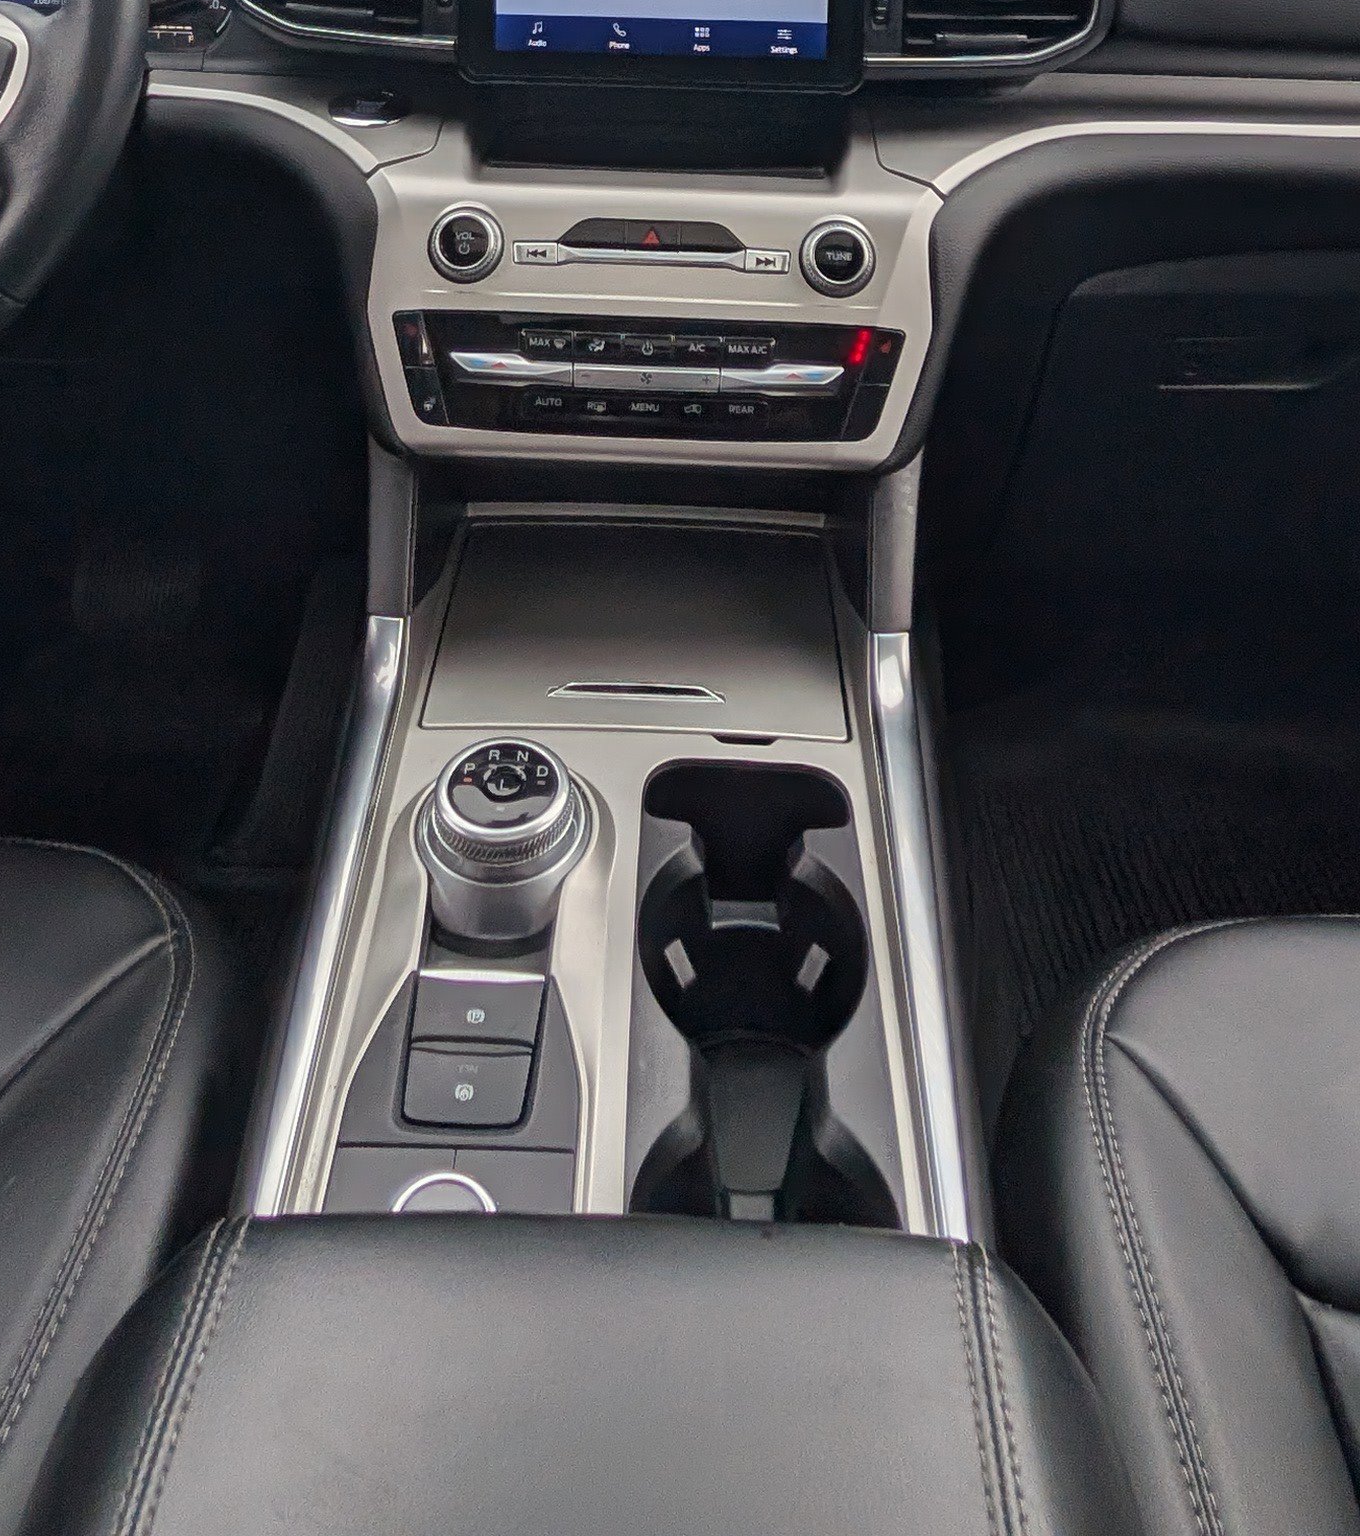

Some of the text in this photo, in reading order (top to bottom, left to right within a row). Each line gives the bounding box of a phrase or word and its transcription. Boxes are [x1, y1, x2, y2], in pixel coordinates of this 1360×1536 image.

[527, 39, 548, 47] Audio
[608, 40, 630, 50] Phone
[693, 44, 711, 53] Apps
[770, 46, 798, 55] Settings
[455, 231, 475, 240] VOL
[825, 250, 853, 262] TUNE
[529, 337, 550, 348] MAX
[689, 342, 705, 353] A/C
[728, 344, 768, 355] MAX A/C
[535, 396, 562, 407] AUTO
[630, 402, 660, 413] MENU
[729, 404, 755, 414] REAR
[488, 749, 500, 761] R
[516, 750, 529, 762] N
[463, 762, 476, 775] P
[536, 765, 549, 777] D
